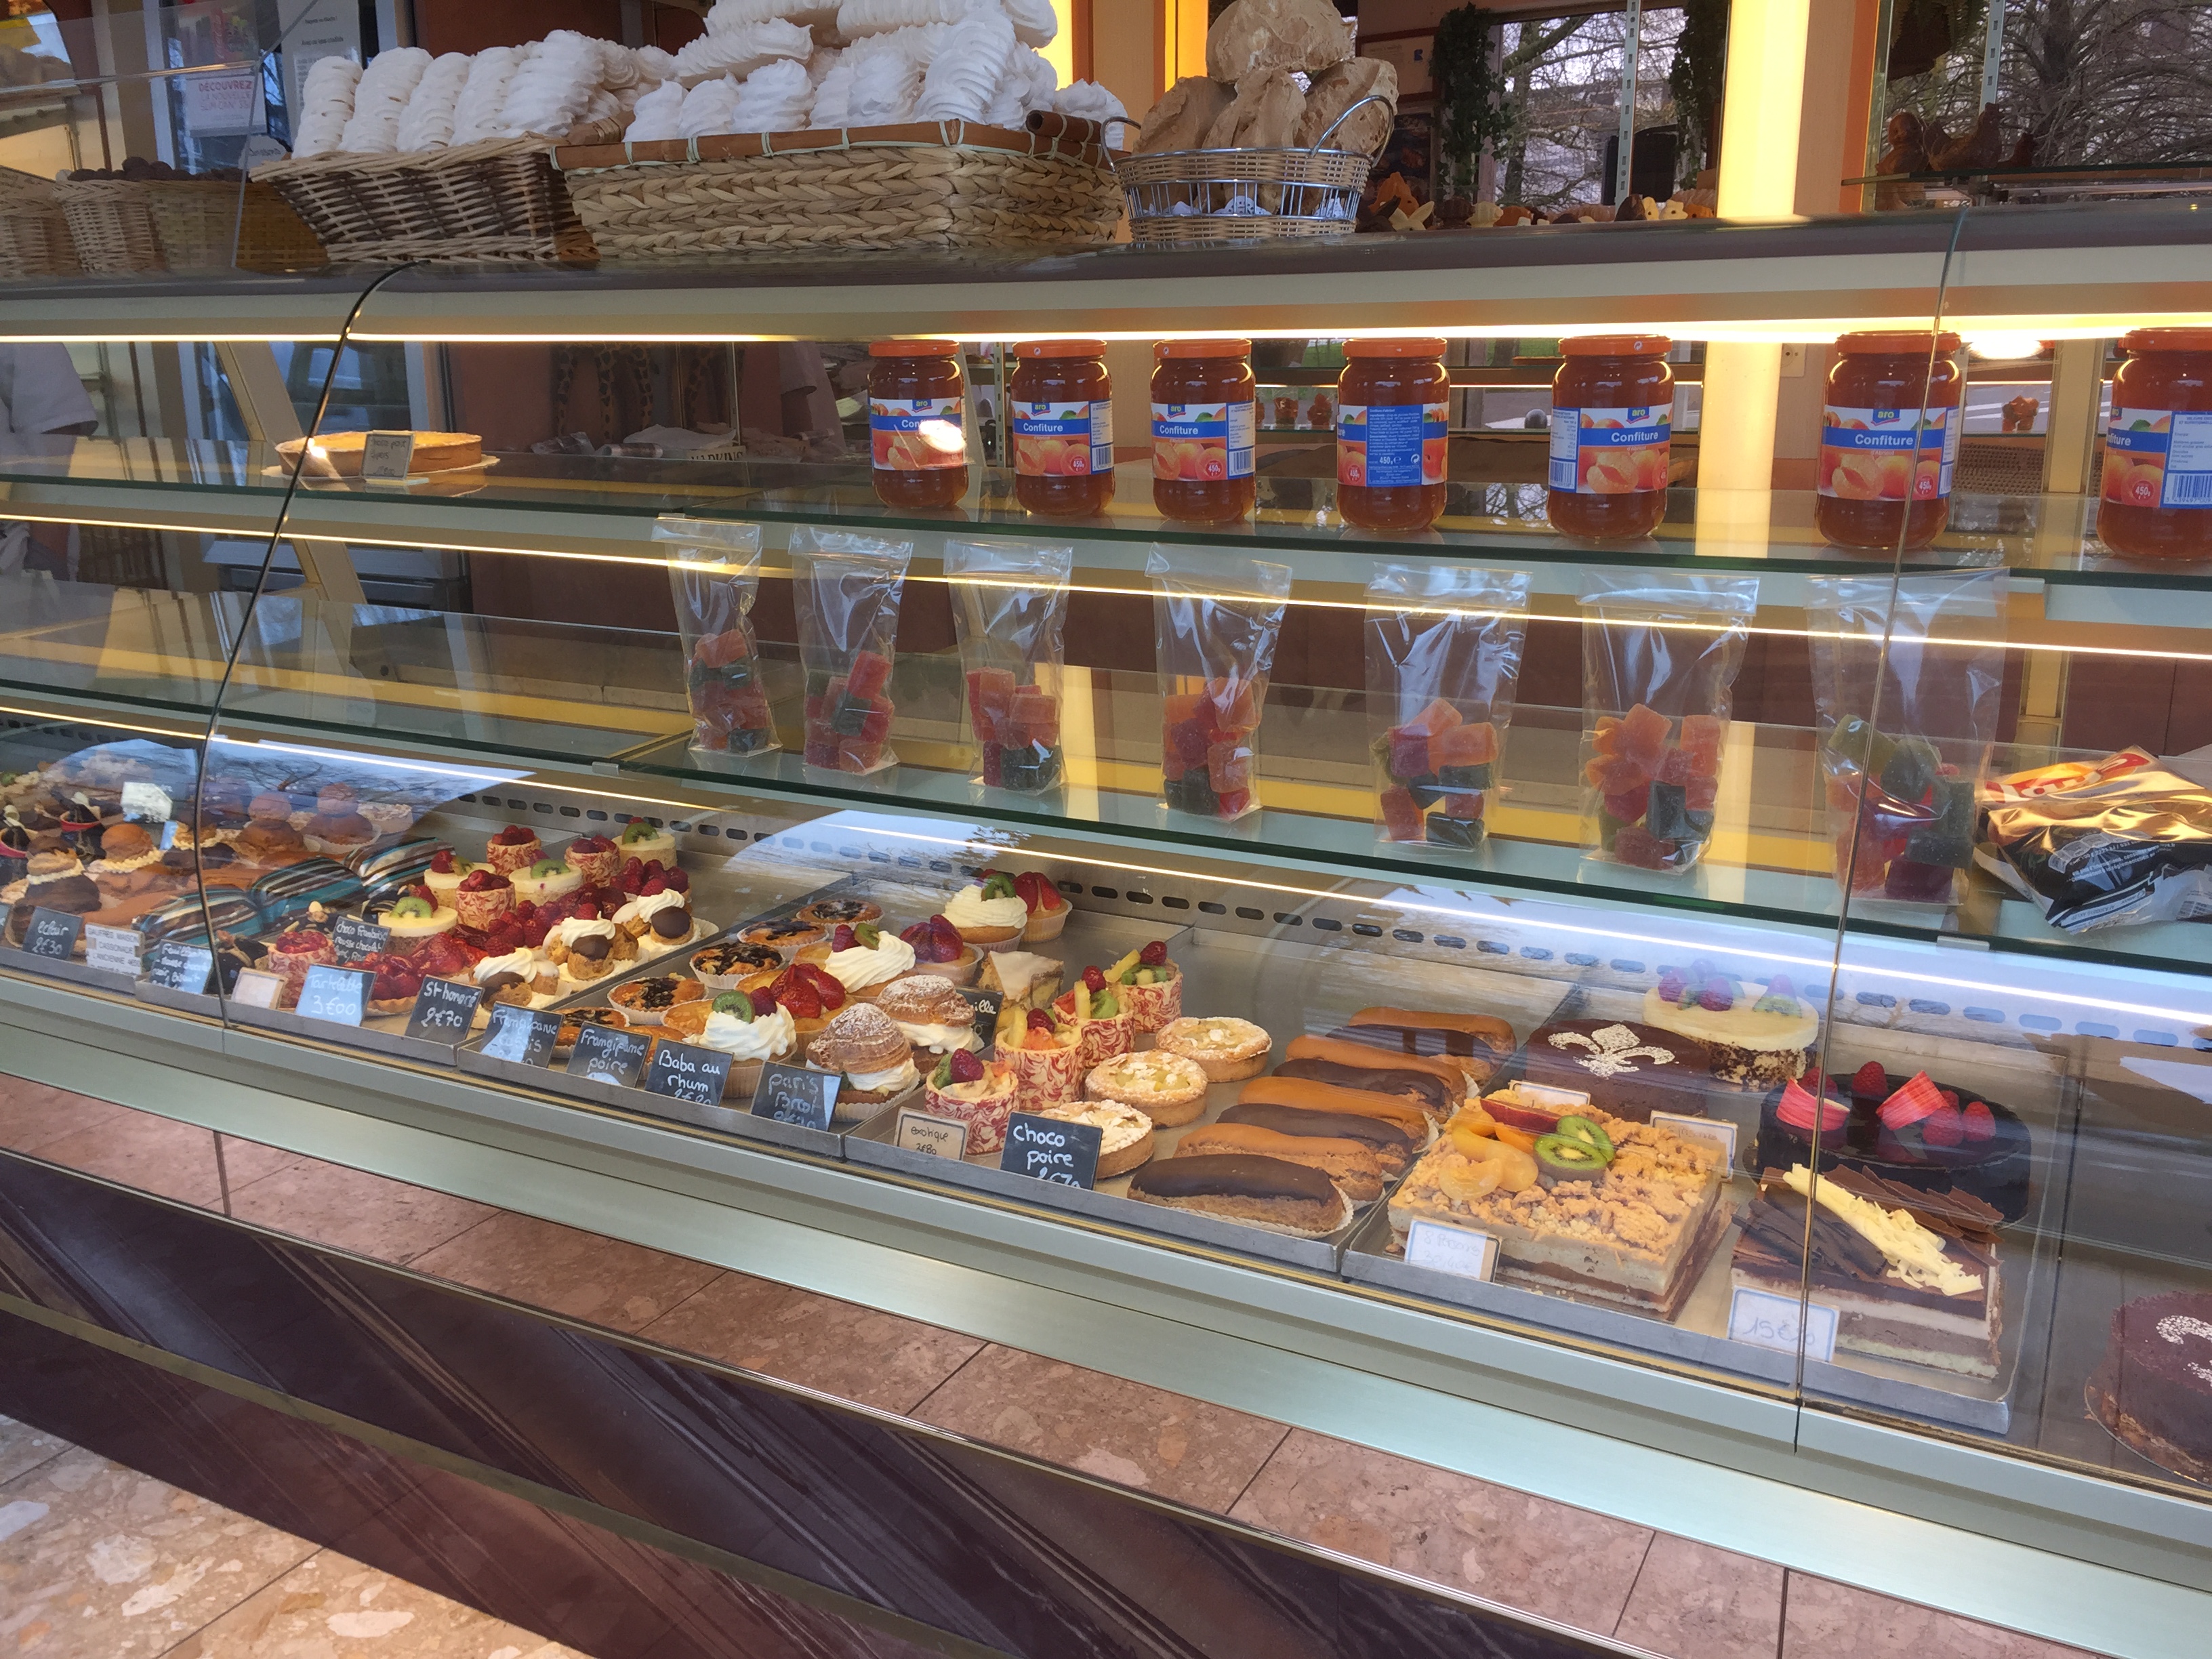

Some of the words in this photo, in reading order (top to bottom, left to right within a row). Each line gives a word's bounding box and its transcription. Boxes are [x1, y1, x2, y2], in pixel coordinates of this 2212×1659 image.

[1631, 409, 1646, 417] aro
[1877, 410, 1896, 419] aro
[1023, 422, 1064, 432] Confiture
[1159, 424, 1199, 435] Confiture
[1610, 431, 1659, 443] Confiture
[1854, 433, 1914, 447] Confiture
[310, 994, 357, 1016] 3€00
[580, 1028, 646, 1059] Frangipane
[586, 1057, 629, 1076] poire
[658, 1049, 697, 1073] Baba
[701, 1063, 720, 1075] au
[667, 1073, 709, 1092] rhum
[910, 1126, 949, 1143] exotique
[1027, 1149, 1074, 1170] poire
